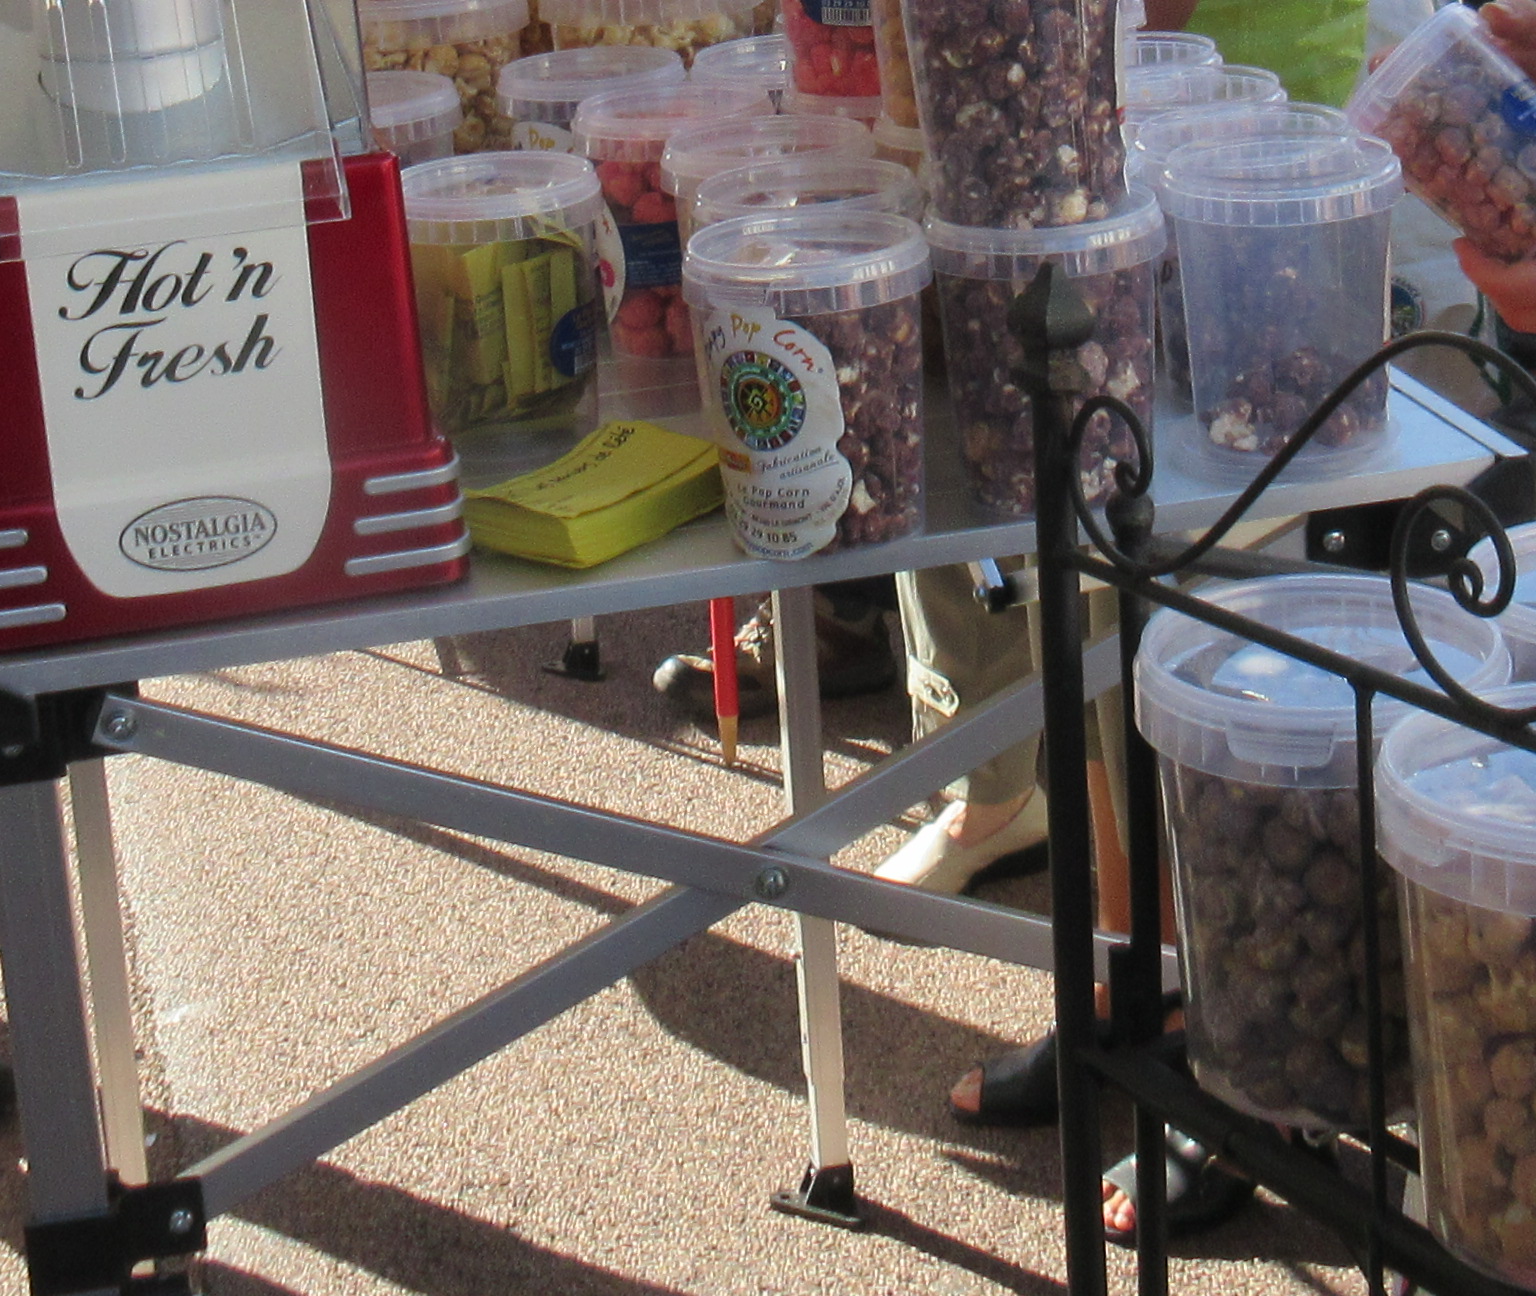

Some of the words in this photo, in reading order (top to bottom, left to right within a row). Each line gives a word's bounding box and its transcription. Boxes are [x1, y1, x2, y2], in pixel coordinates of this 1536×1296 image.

[58, 240, 214, 320] Hot
[75, 313, 282, 400] Fresh
[730, 313, 762, 344] Pop
[772, 329, 814, 372] Corn
[757, 446, 823, 475] Fabrication
[778, 449, 835, 480] artisanale
[744, 496, 805, 510] Gourmand
[751, 485, 773, 500] Pop
[777, 487, 811, 498] Corn
[134, 512, 266, 547] NOSTALGIA
